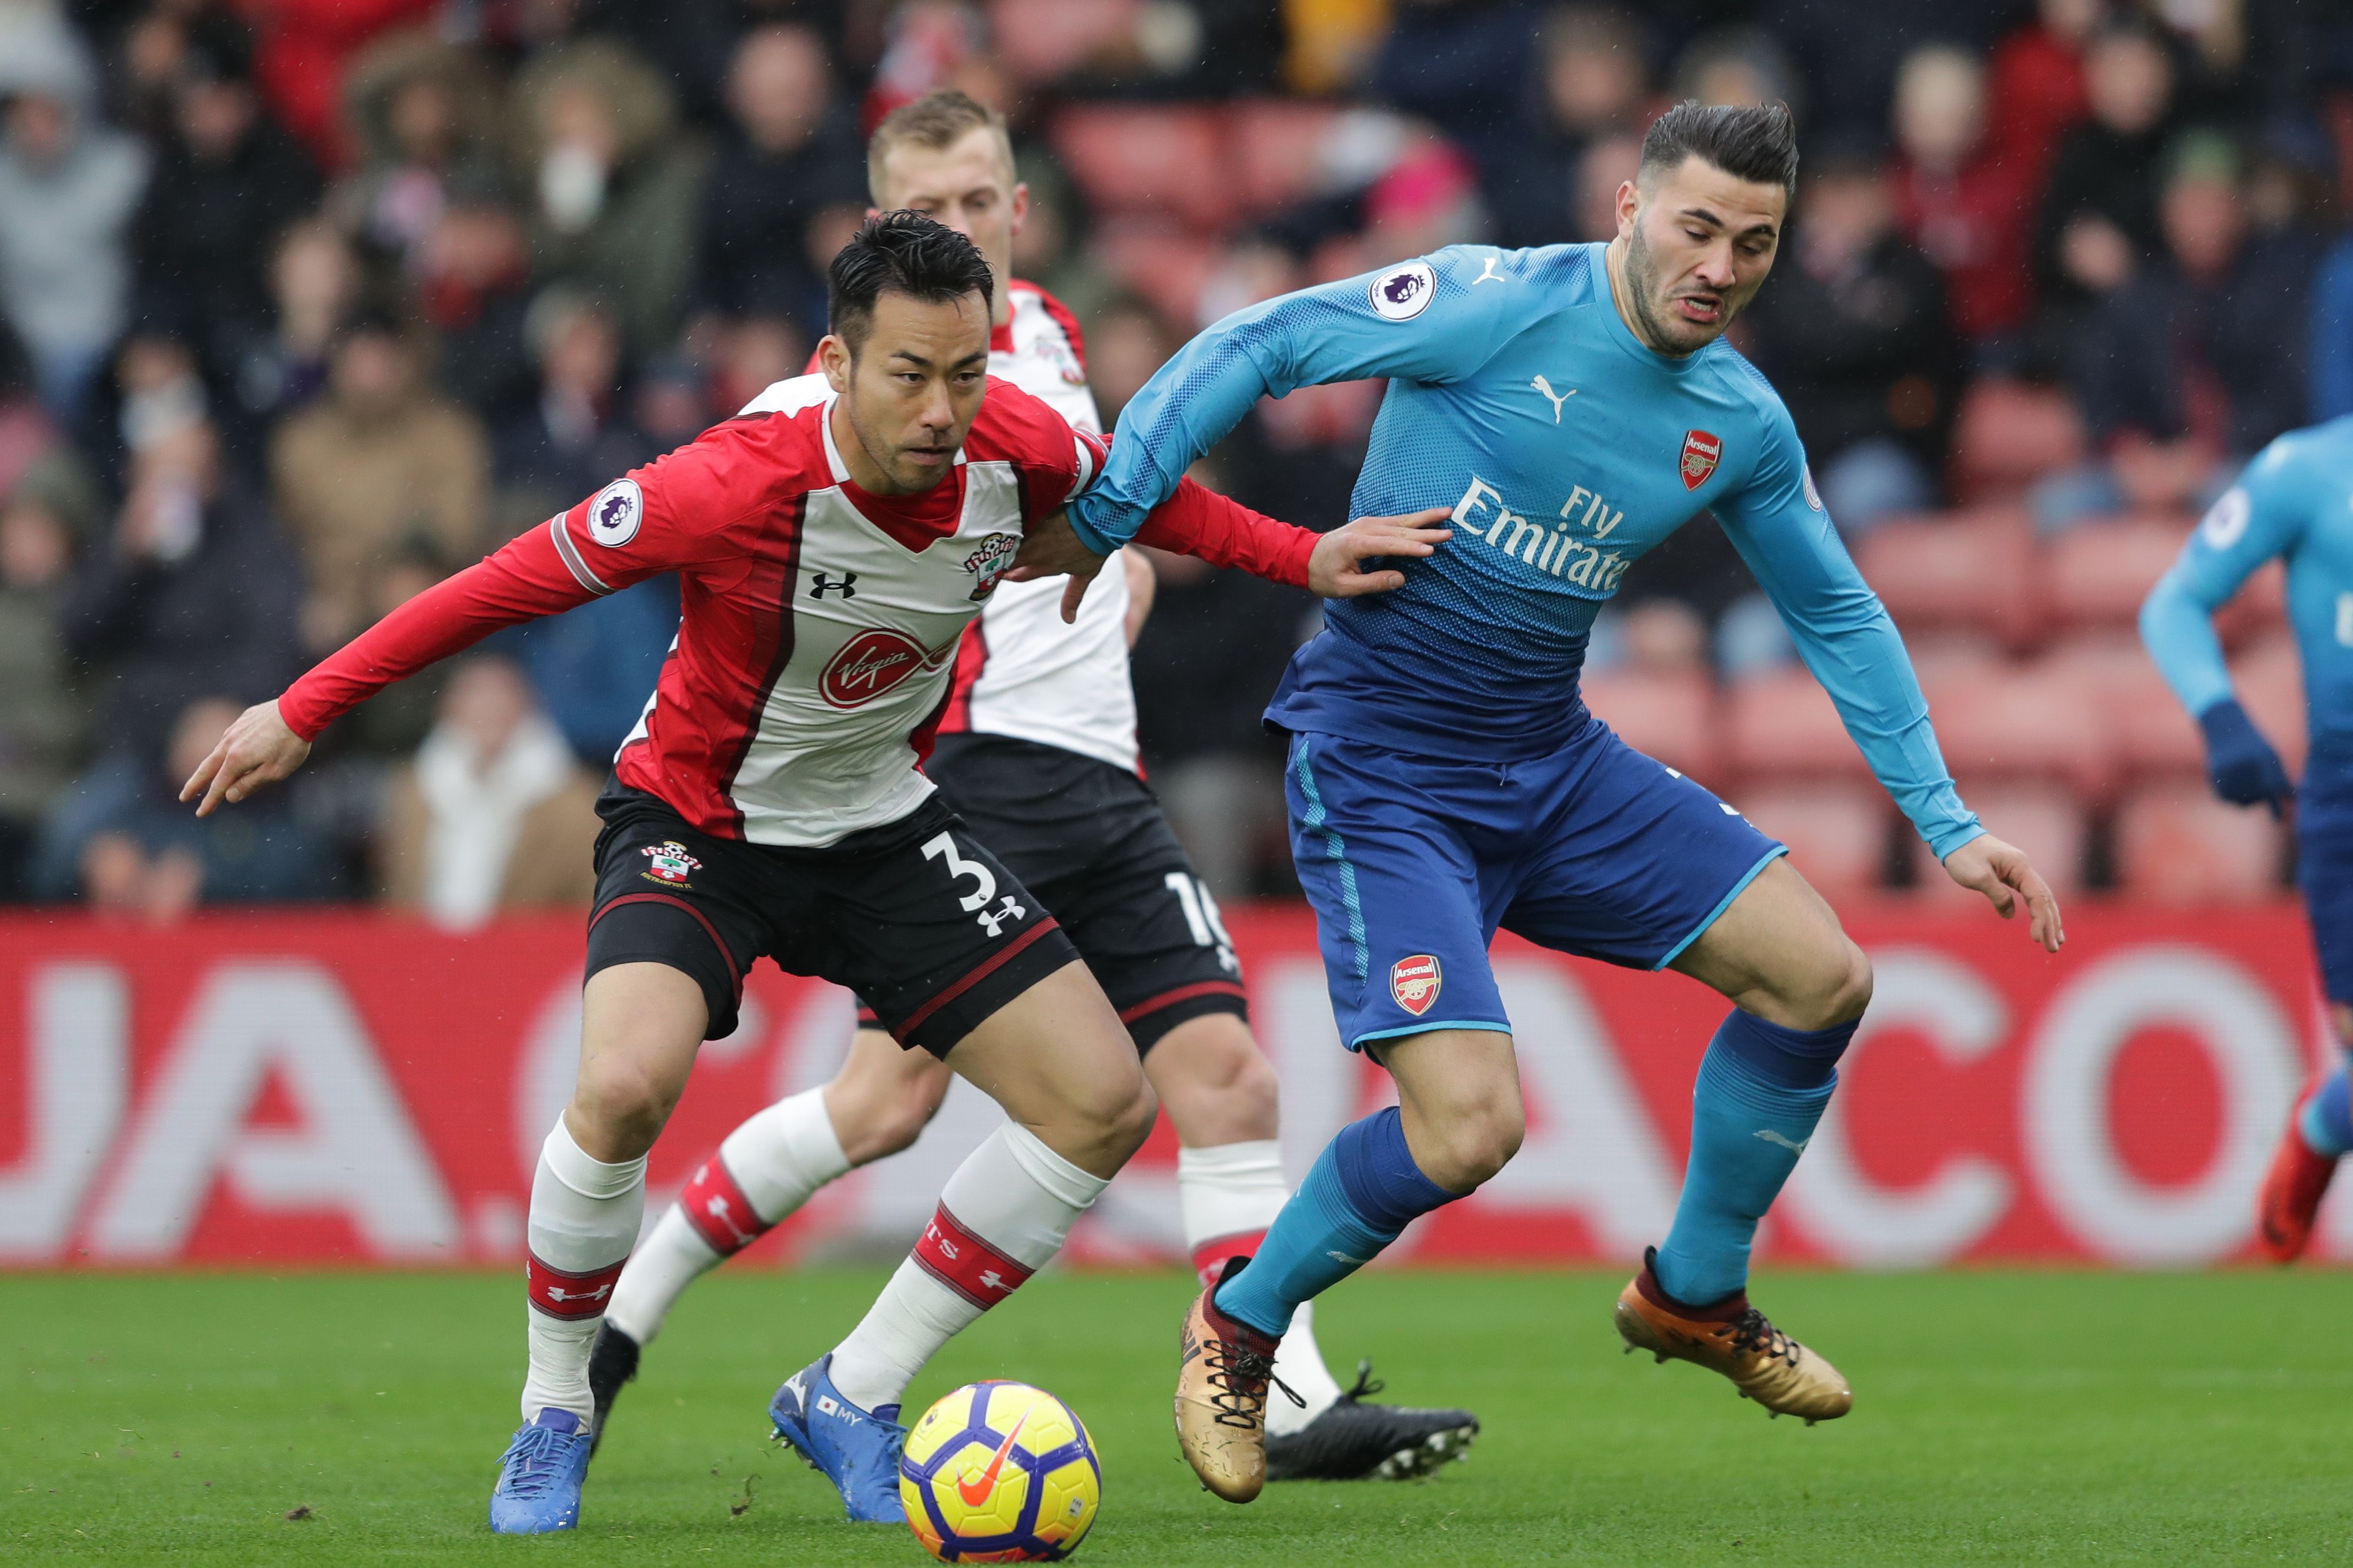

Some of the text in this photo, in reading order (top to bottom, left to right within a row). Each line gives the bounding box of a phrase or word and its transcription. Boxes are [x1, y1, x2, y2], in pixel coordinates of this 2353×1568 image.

[1687, 437, 1717, 456] Arsenal
[1451, 476, 1631, 590] Emirate
[1560, 484, 1624, 539] Fly
[837, 646, 910, 689] Virgin
[920, 830, 996, 912] 3
[1396, 962, 1433, 979] Arsenal
[837, 1406, 863, 1426] MY
